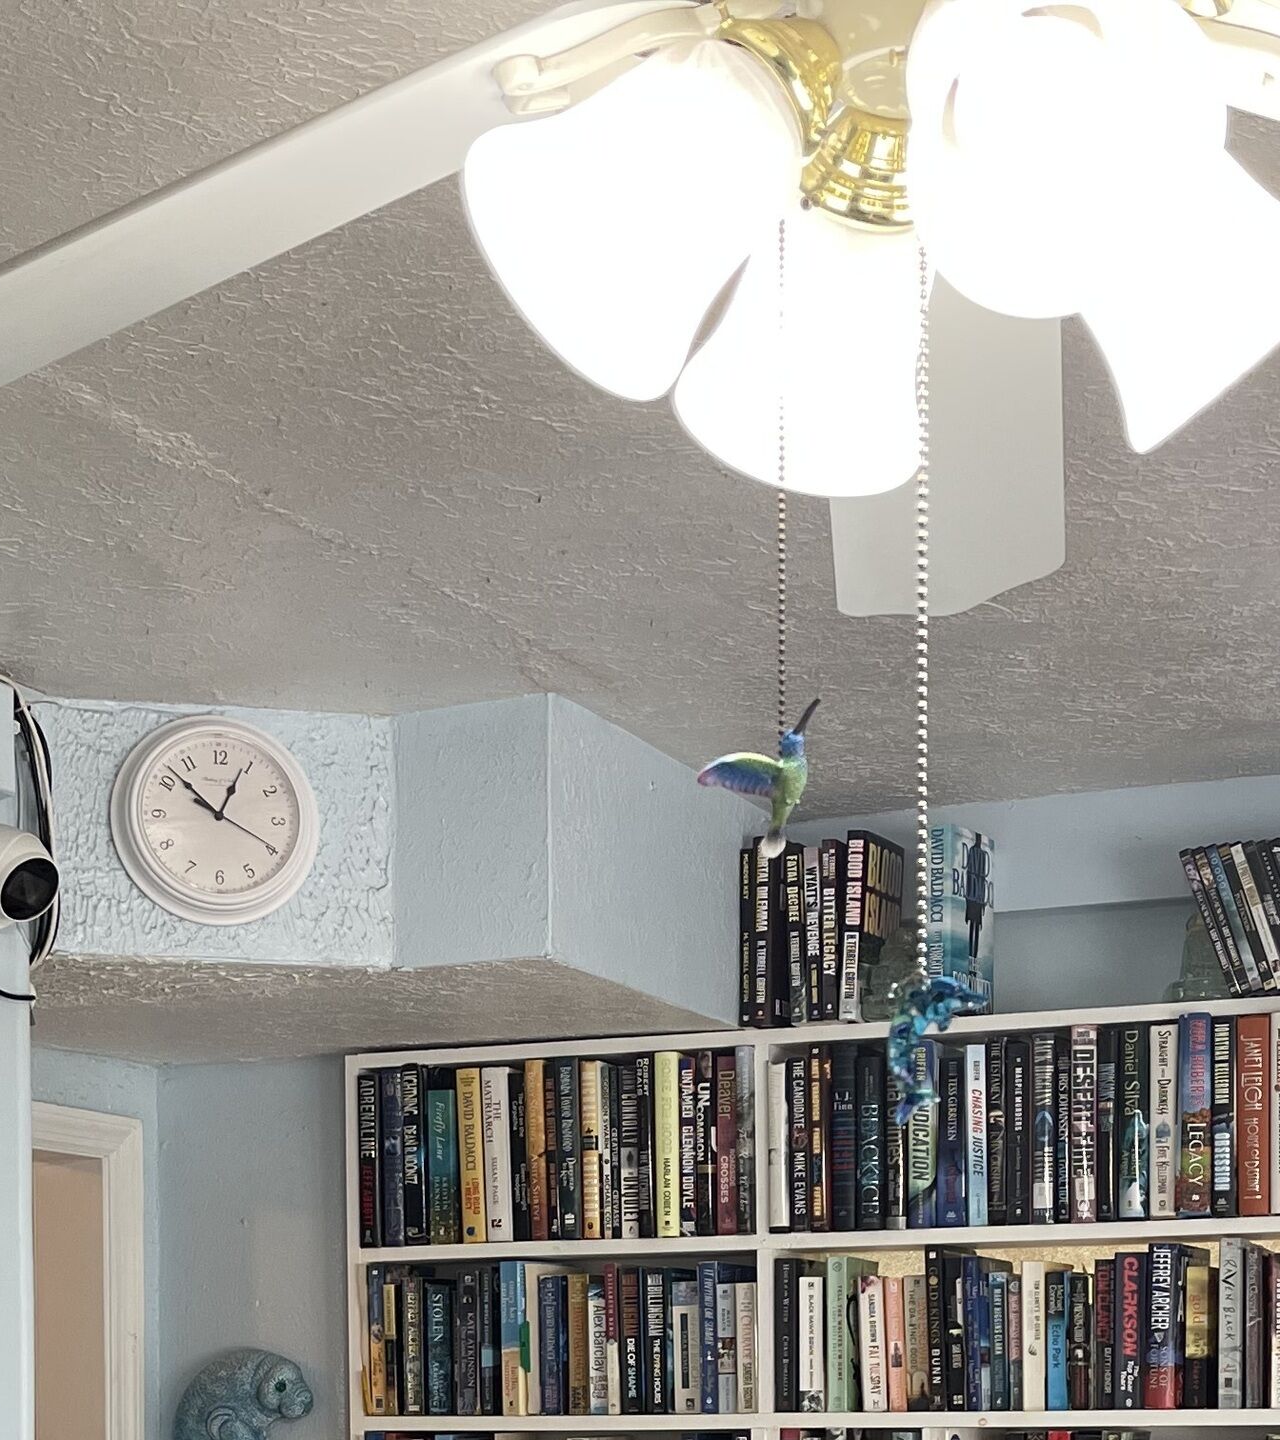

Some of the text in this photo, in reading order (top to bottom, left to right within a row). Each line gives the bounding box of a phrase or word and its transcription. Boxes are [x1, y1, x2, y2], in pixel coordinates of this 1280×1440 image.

[181, 756, 197, 772] 11
[213, 750, 228, 765] 12
[243, 761, 253, 775] 1
[159, 775, 175, 792] 10
[263, 785, 277, 797] 2
[152, 809, 167, 819] 9
[271, 817, 285, 826] 3
[160, 838, 174, 850] 8
[265, 843, 278, 856] 4
[931, 828, 944, 860] DAVID
[184, 860, 197, 873] 7
[215, 870, 224, 885] 6
[243, 864, 255, 878] 5
[786, 855, 798, 883] FATAL
[846, 839, 864, 925] BLOOD ISLAND
[824, 931, 836, 976] LEGACY
[641, 1058, 649, 1096] ROBERT
[916, 1047, 926, 1081] GRIFFIN
[1124, 1030, 1139, 1116] Daniel Silva
[681, 1069, 693, 1118] UNTAMED
[719, 1070, 735, 1119] Deaver
[948, 1079, 957, 1101] TESS
[360, 1080, 375, 1159] ADRENALINE
[463, 1092, 474, 1125] DAVID
[484, 1079, 492, 1144] MATRIARCH
[493, 1101, 502, 1121] THE
[794, 1061, 806, 1215] THE CANDIDATE MIKE EVANS
[970, 1089, 984, 1177] CHASING JUSTICE
[1187, 1123, 1206, 1187] LEGACY
[1214, 1132, 1230, 1191] OBSESSION
[721, 1156, 729, 1204] CROSSES
[1123, 1256, 1137, 1357] CLARKSON
[1151, 1247, 1171, 1331] JEFFREY ARCHER
[433, 1293, 443, 1342] STOLEN
[591, 1305, 607, 1377] Alex Barclay
[1052, 1322, 1062, 1368] Echo Park
[932, 1349, 941, 1384] BUNN
